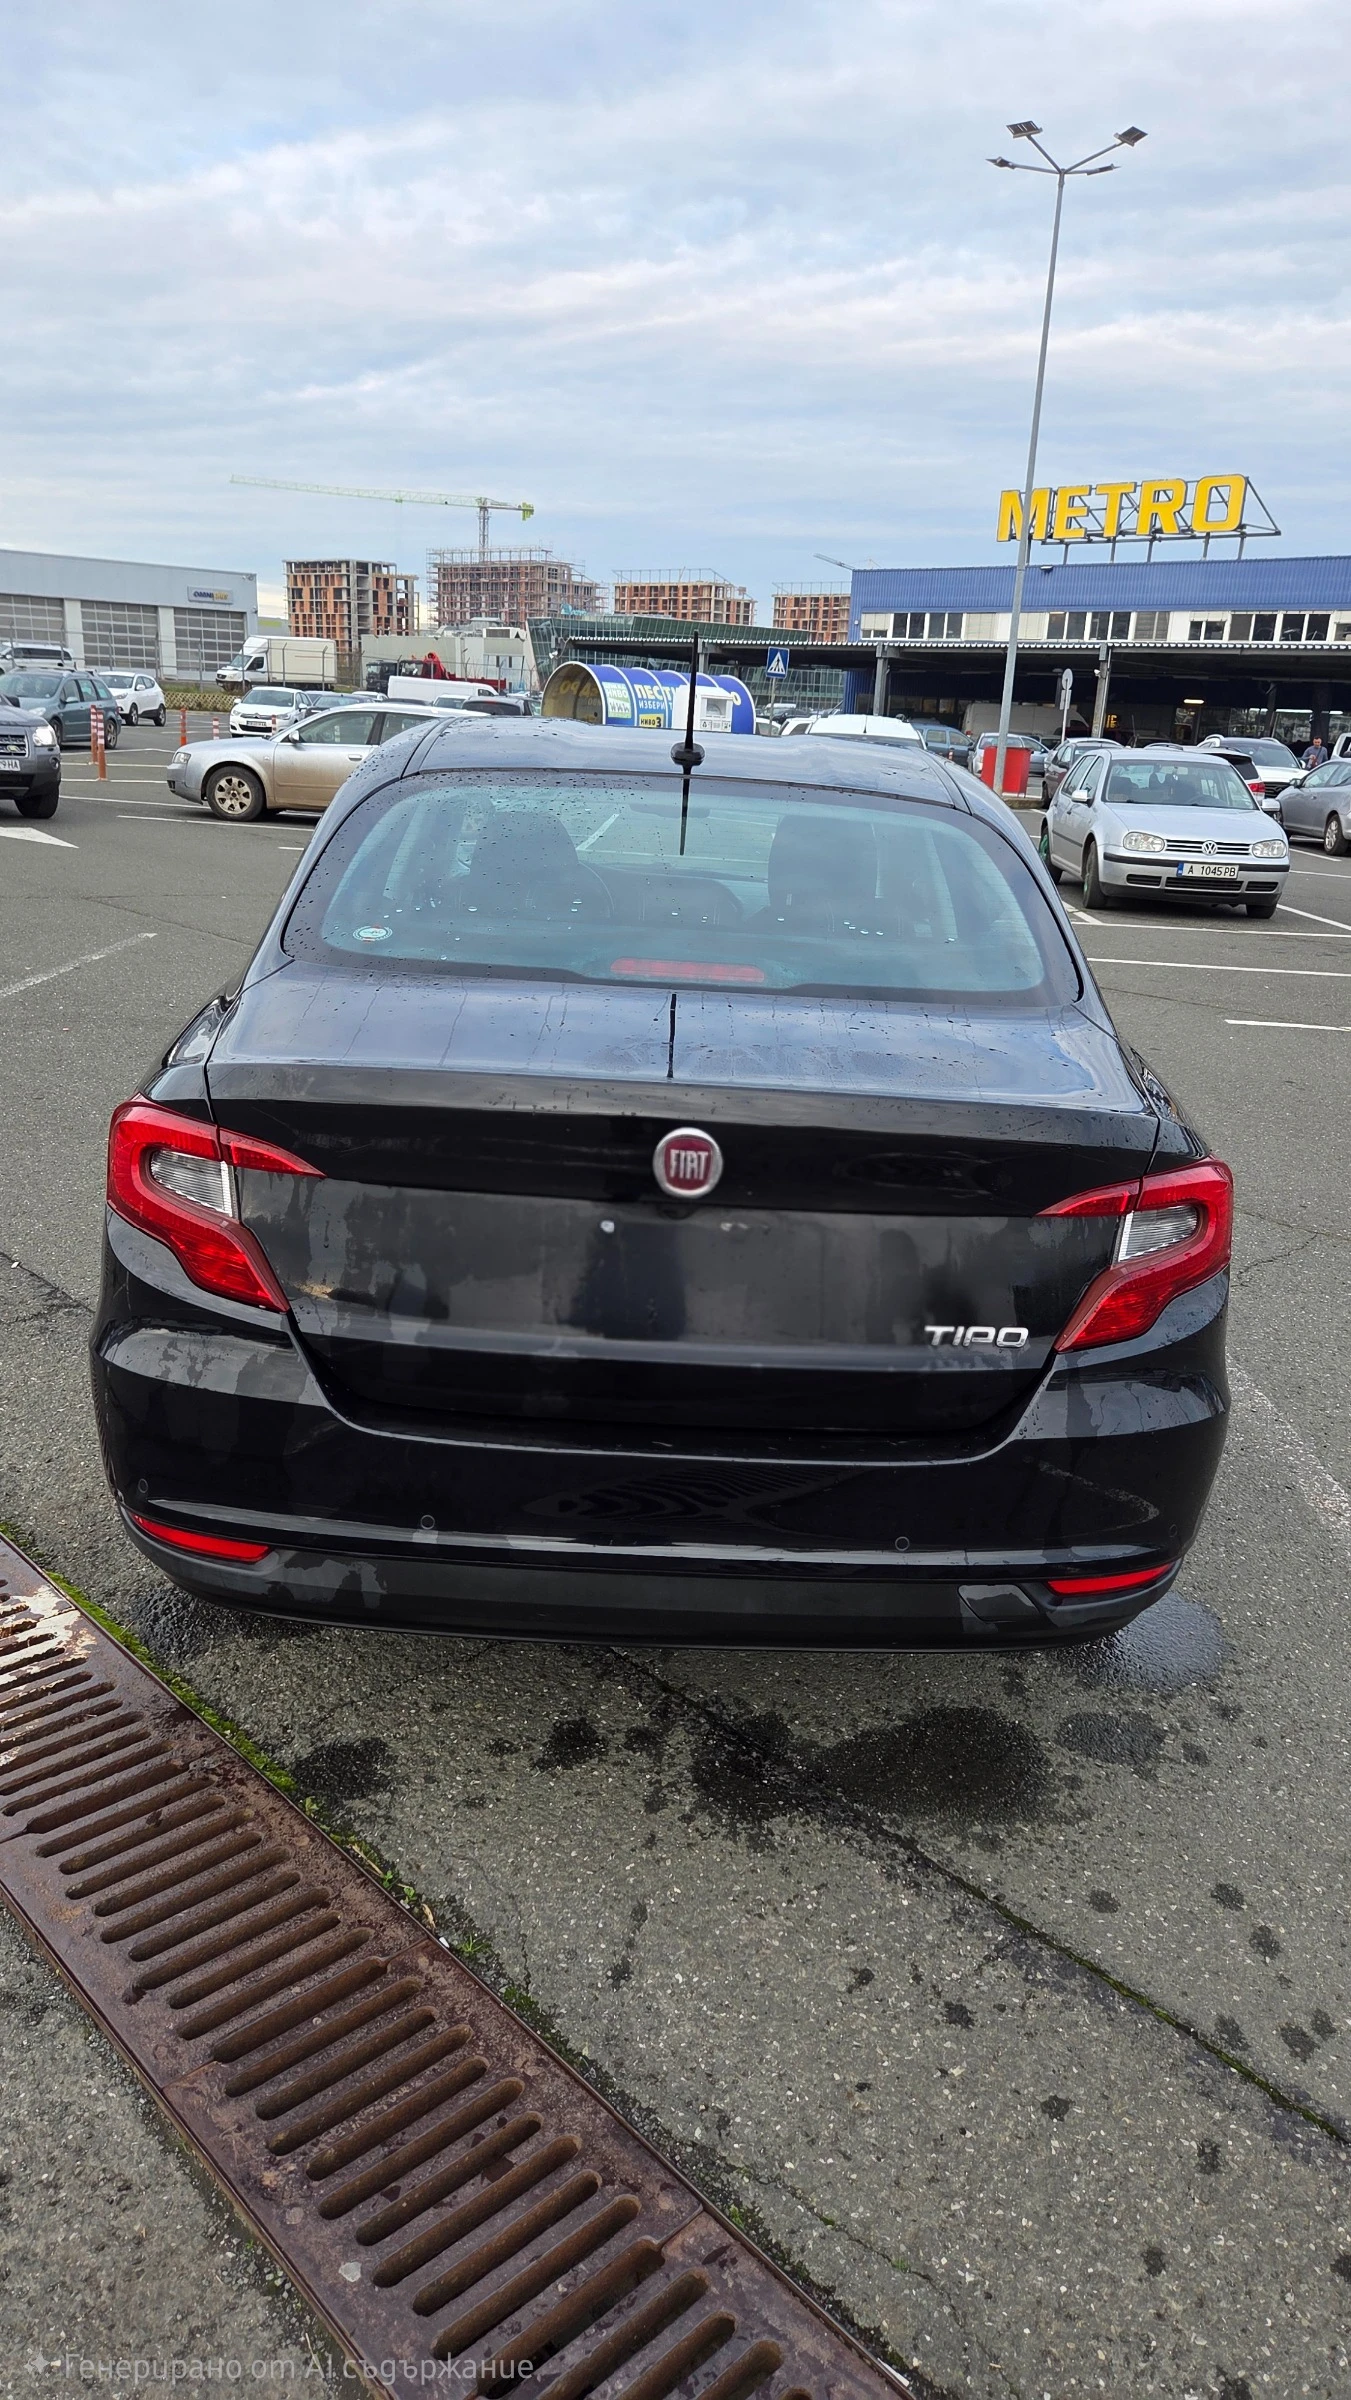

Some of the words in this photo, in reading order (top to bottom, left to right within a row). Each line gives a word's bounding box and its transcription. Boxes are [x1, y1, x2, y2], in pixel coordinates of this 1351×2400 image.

[997, 474, 1247, 541] METRO
[639, 700, 666, 710] ИЗБЕРИ
[640, 718, 656, 726] НИВО
[1188, 865, 1193, 874] A
[670, 1148, 709, 1180] FIAT
[924, 1325, 1029, 1347] TIPO
